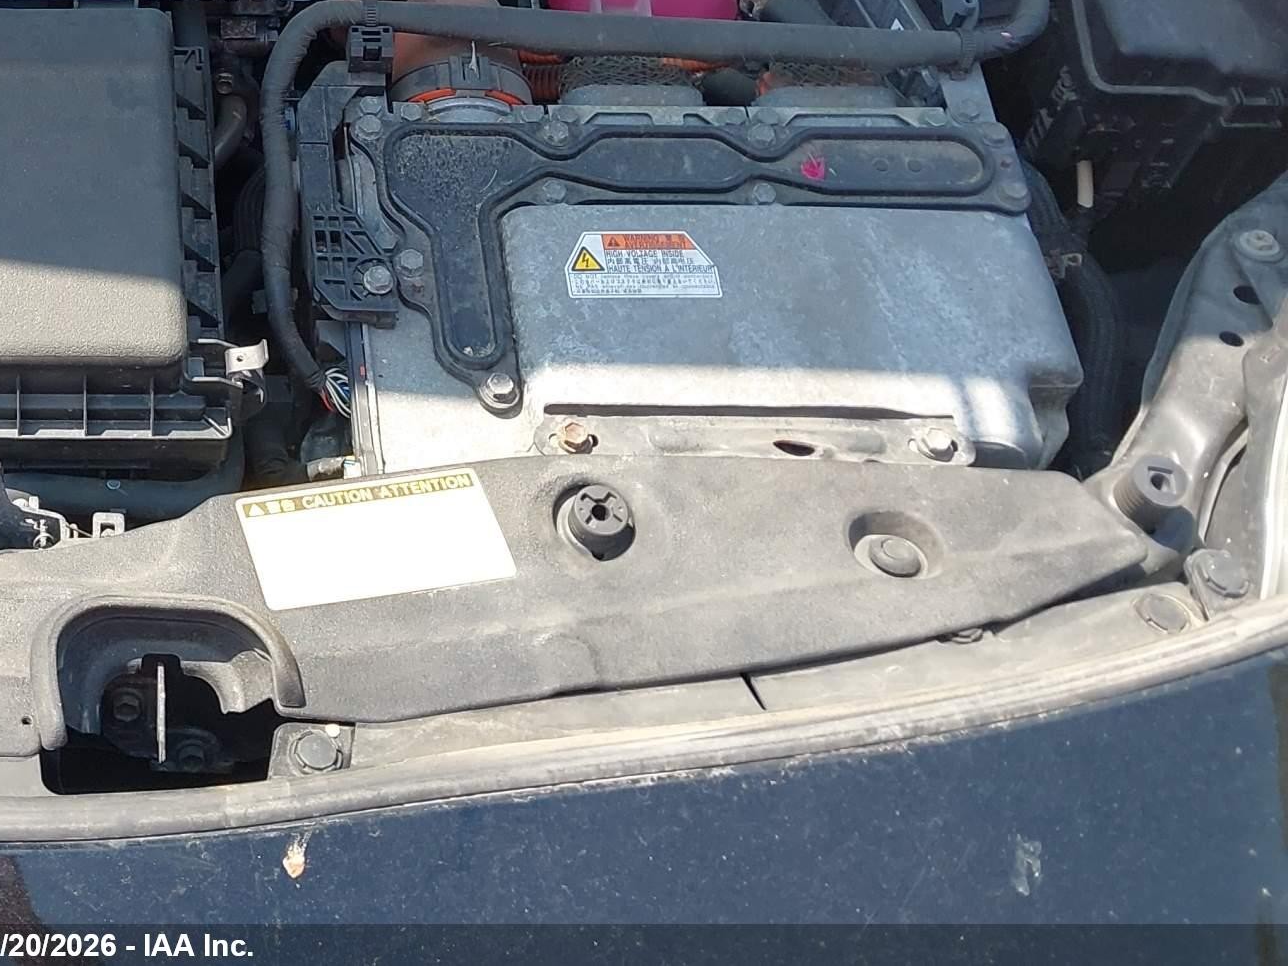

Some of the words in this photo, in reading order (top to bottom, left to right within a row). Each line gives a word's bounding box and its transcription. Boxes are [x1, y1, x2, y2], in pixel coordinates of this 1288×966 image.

[606, 250, 624, 258] HIGH
[627, 250, 658, 258] VOLTAGE
[663, 250, 684, 258] INSIDE
[608, 265, 631, 273] HAUTE
[633, 265, 663, 273] TENSION
[302, 489, 374, 509] CAUTION
[380, 475, 471, 499] ATTENTION
